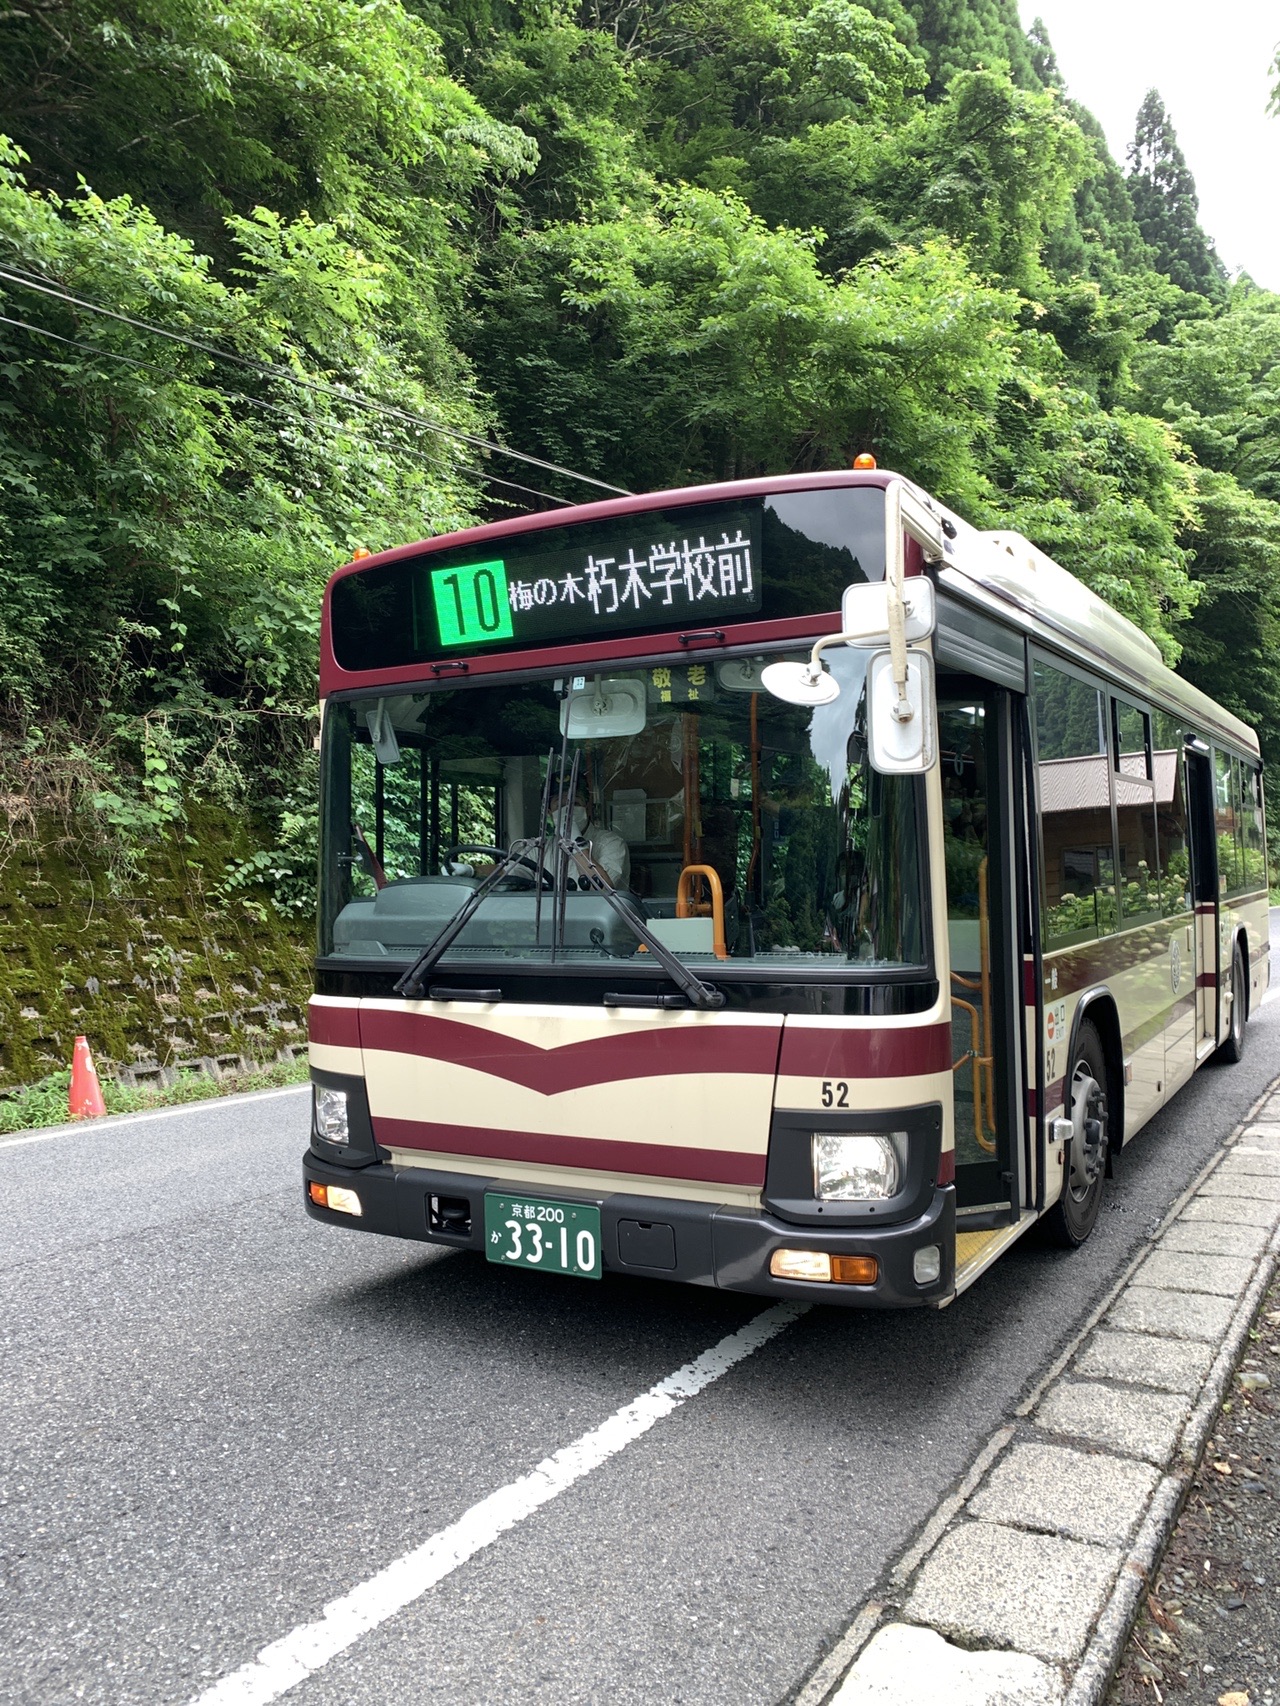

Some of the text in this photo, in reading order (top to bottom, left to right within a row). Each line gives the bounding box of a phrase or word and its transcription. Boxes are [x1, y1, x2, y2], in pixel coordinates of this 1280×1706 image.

[443, 530, 753, 636] 10 梅の木 朽木学校前
[1046, 1048, 1056, 1082] 52
[821, 1081, 850, 1108] 52
[490, 1220, 596, 1272] か 33-10
